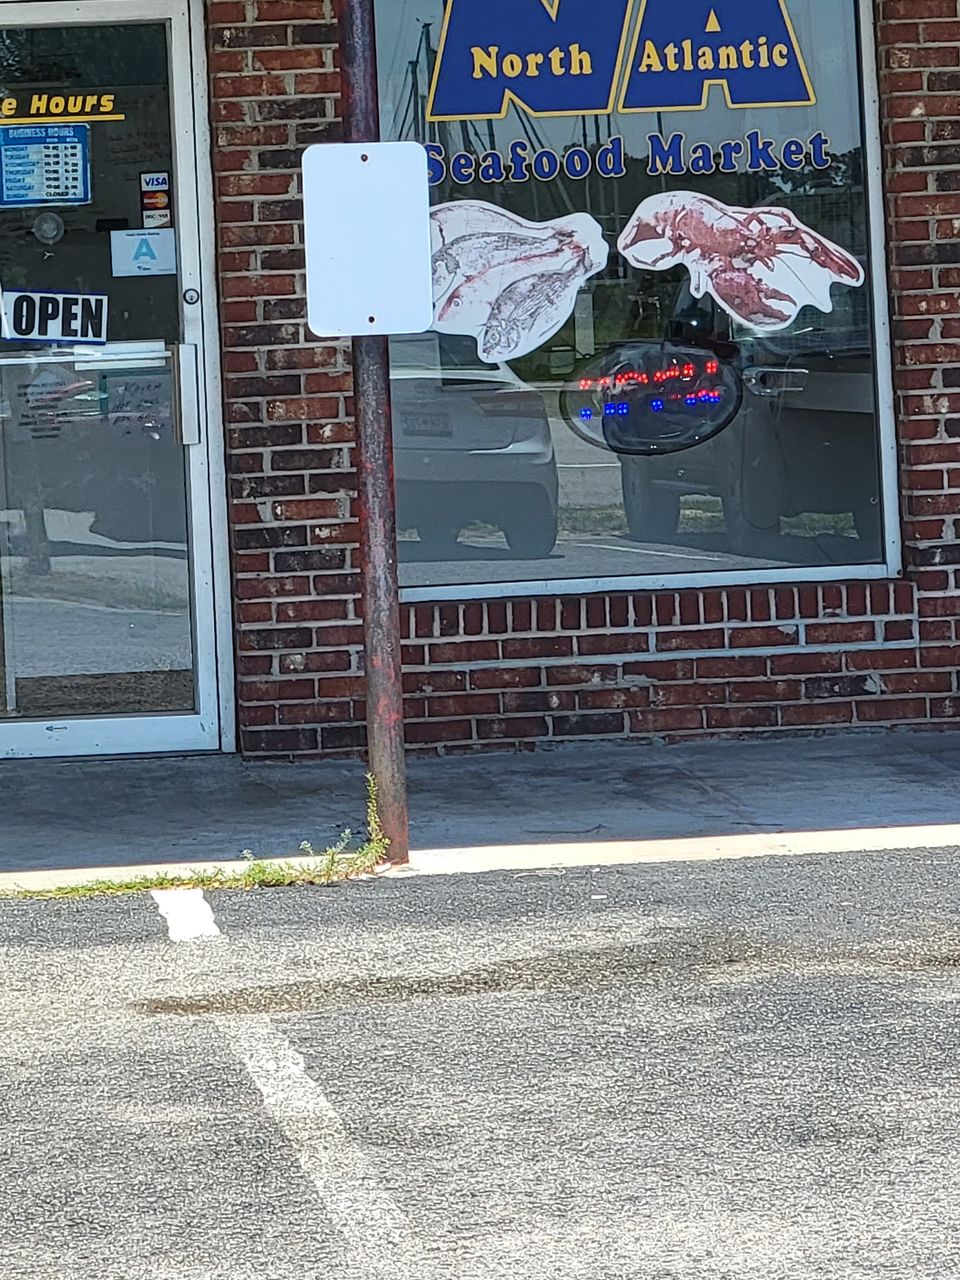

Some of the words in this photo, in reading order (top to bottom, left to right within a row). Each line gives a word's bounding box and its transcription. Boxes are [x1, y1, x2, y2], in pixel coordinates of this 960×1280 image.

[469, 43, 593, 79] North
[638, 36, 789, 73] Atlantic
[29, 94, 116, 115] Hours
[425, 135, 627, 185] Seafood
[645, 129, 832, 177] Market
[144, 177, 168, 187] VISA
[133, 238, 157, 261] A
[13, 294, 103, 339] OPEN
